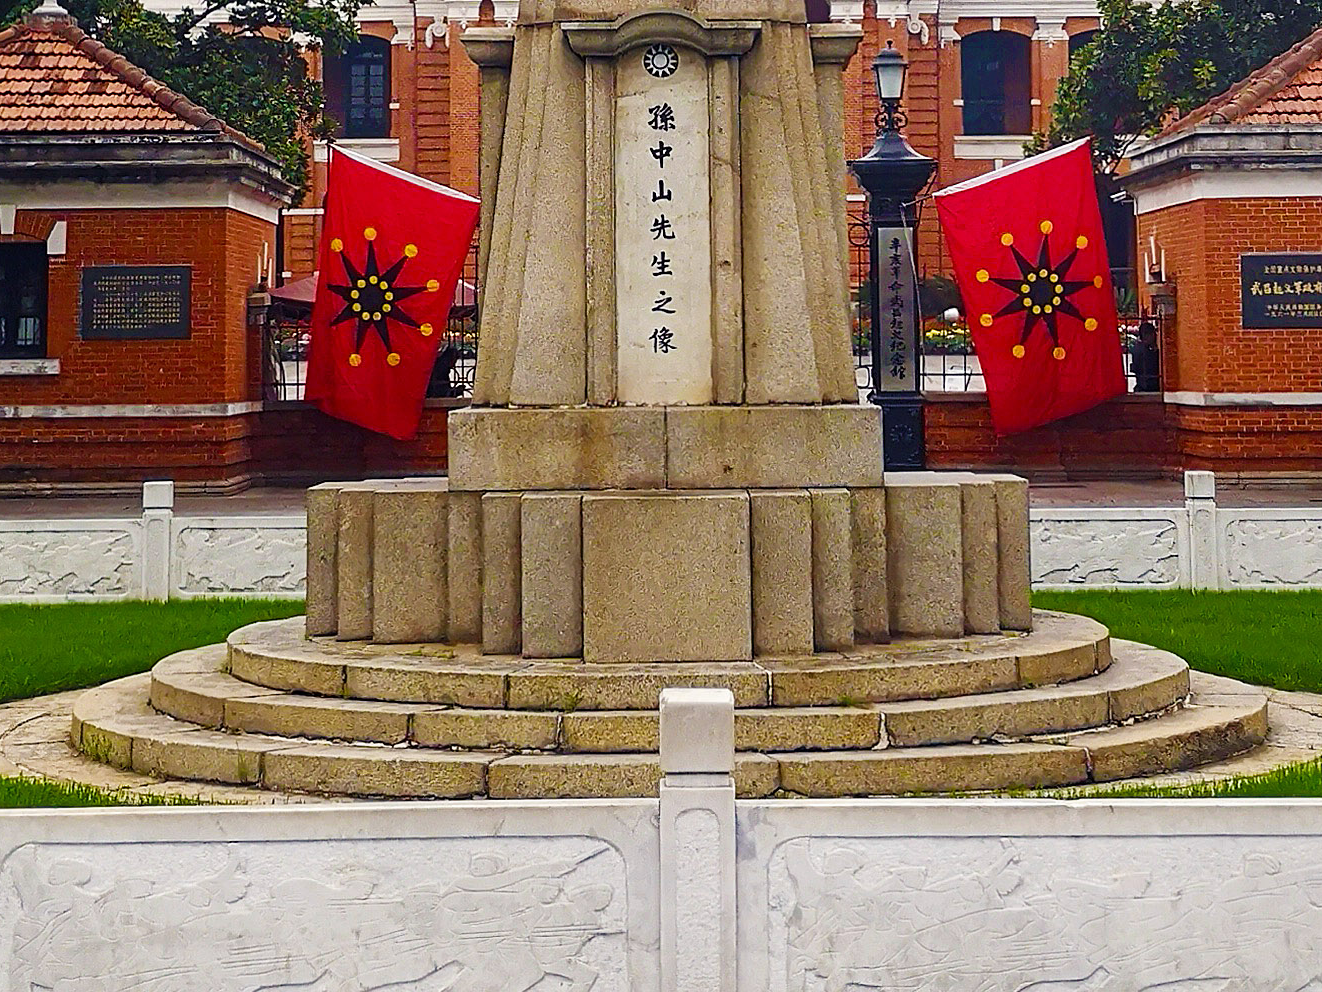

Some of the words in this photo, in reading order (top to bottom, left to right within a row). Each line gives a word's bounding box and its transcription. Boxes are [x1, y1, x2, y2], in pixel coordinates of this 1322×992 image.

[648, 103, 677, 354] 孫中山先生之像
